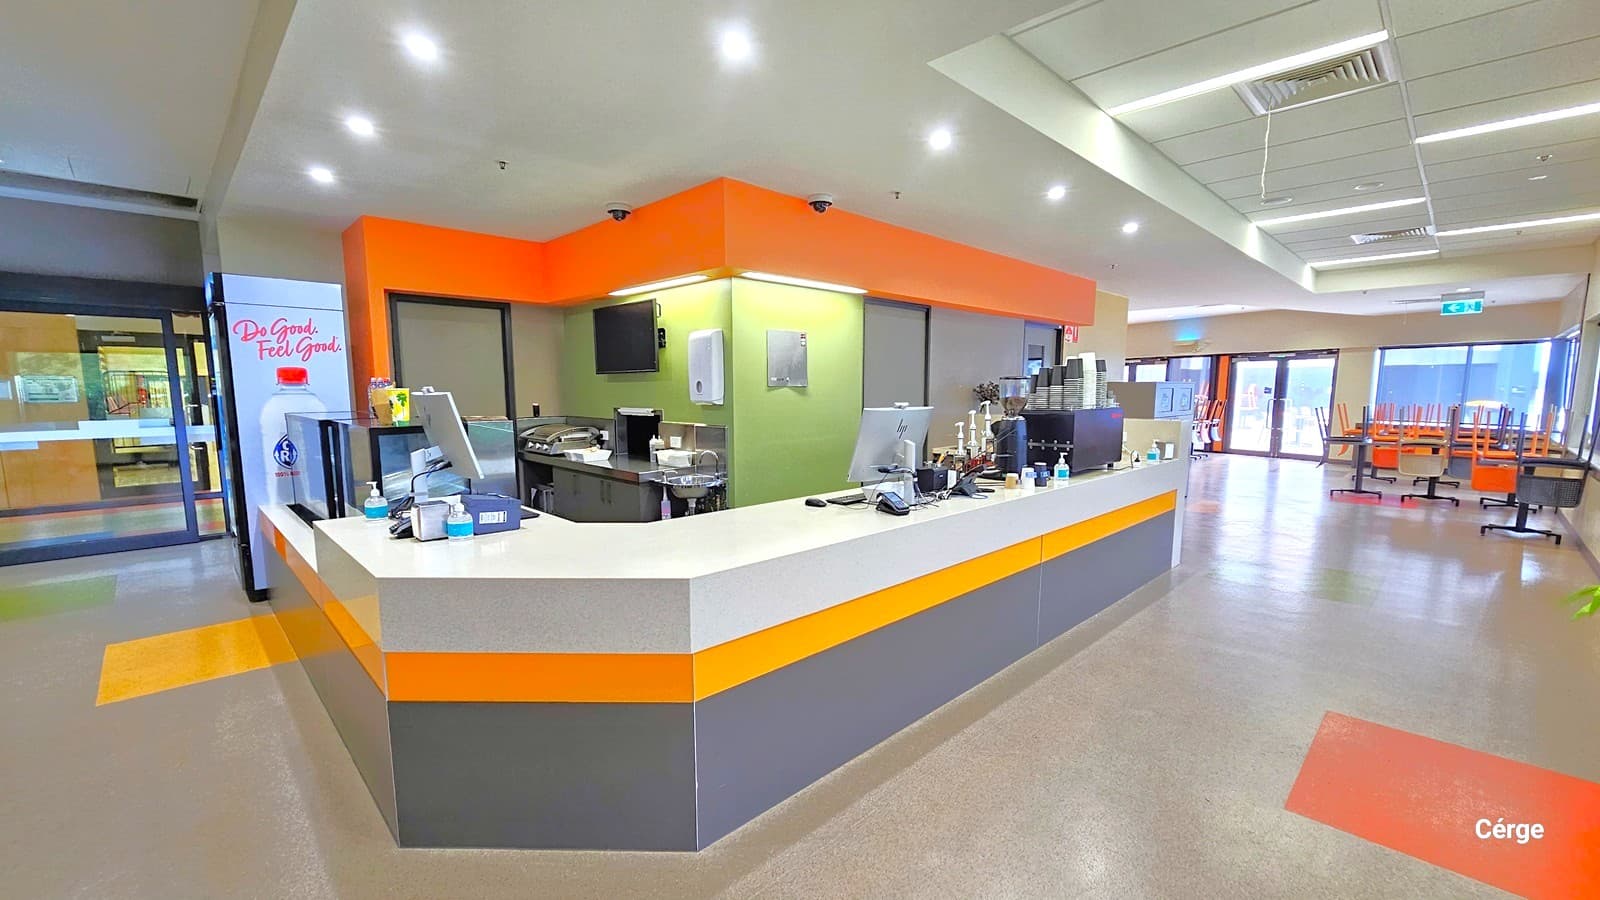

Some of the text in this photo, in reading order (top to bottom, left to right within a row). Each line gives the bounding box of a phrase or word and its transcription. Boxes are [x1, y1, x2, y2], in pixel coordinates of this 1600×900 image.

[232, 317, 319, 345] Do Good.
[256, 336, 342, 362] Feel Good.
[896, 418, 908, 440] hp
